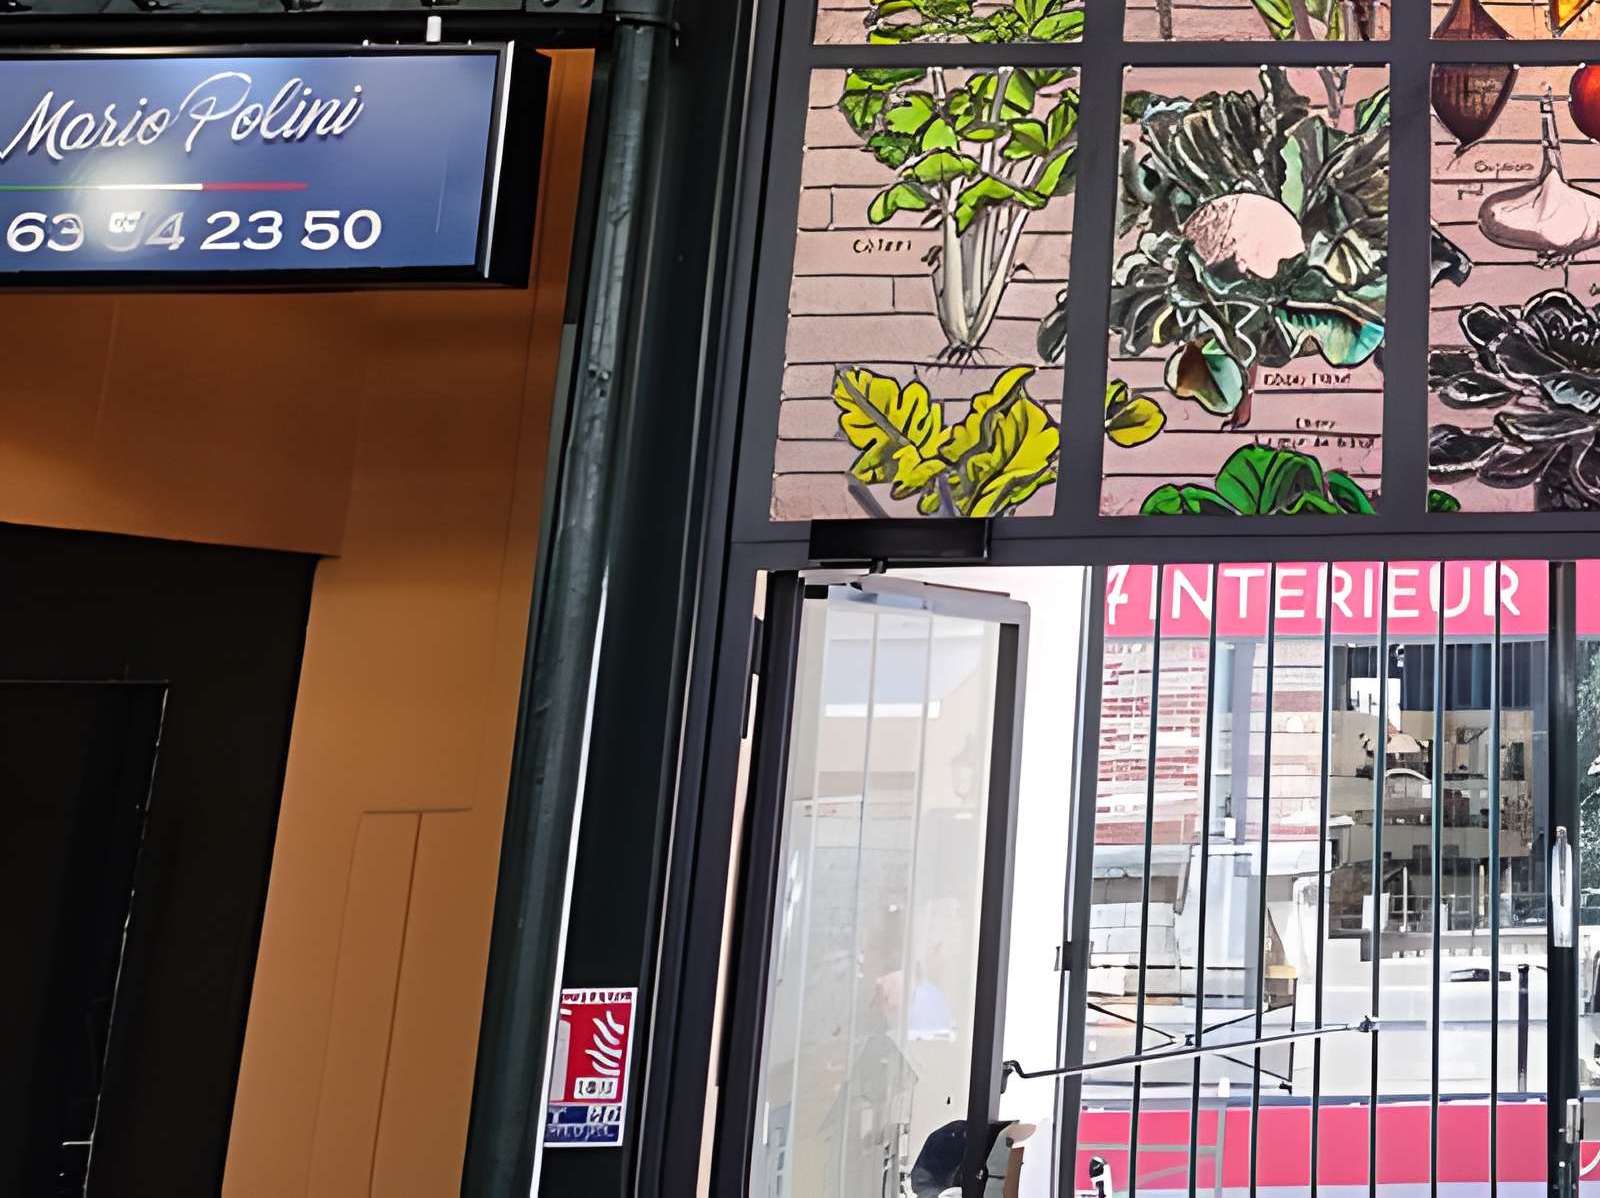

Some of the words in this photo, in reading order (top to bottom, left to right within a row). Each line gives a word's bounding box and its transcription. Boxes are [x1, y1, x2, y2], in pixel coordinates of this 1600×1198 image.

[0, 91, 172, 160] Mario
[170, 71, 365, 153] Polini
[7, 211, 85, 252] 63
[200, 210, 283, 251] 23
[301, 209, 383, 251] 50
